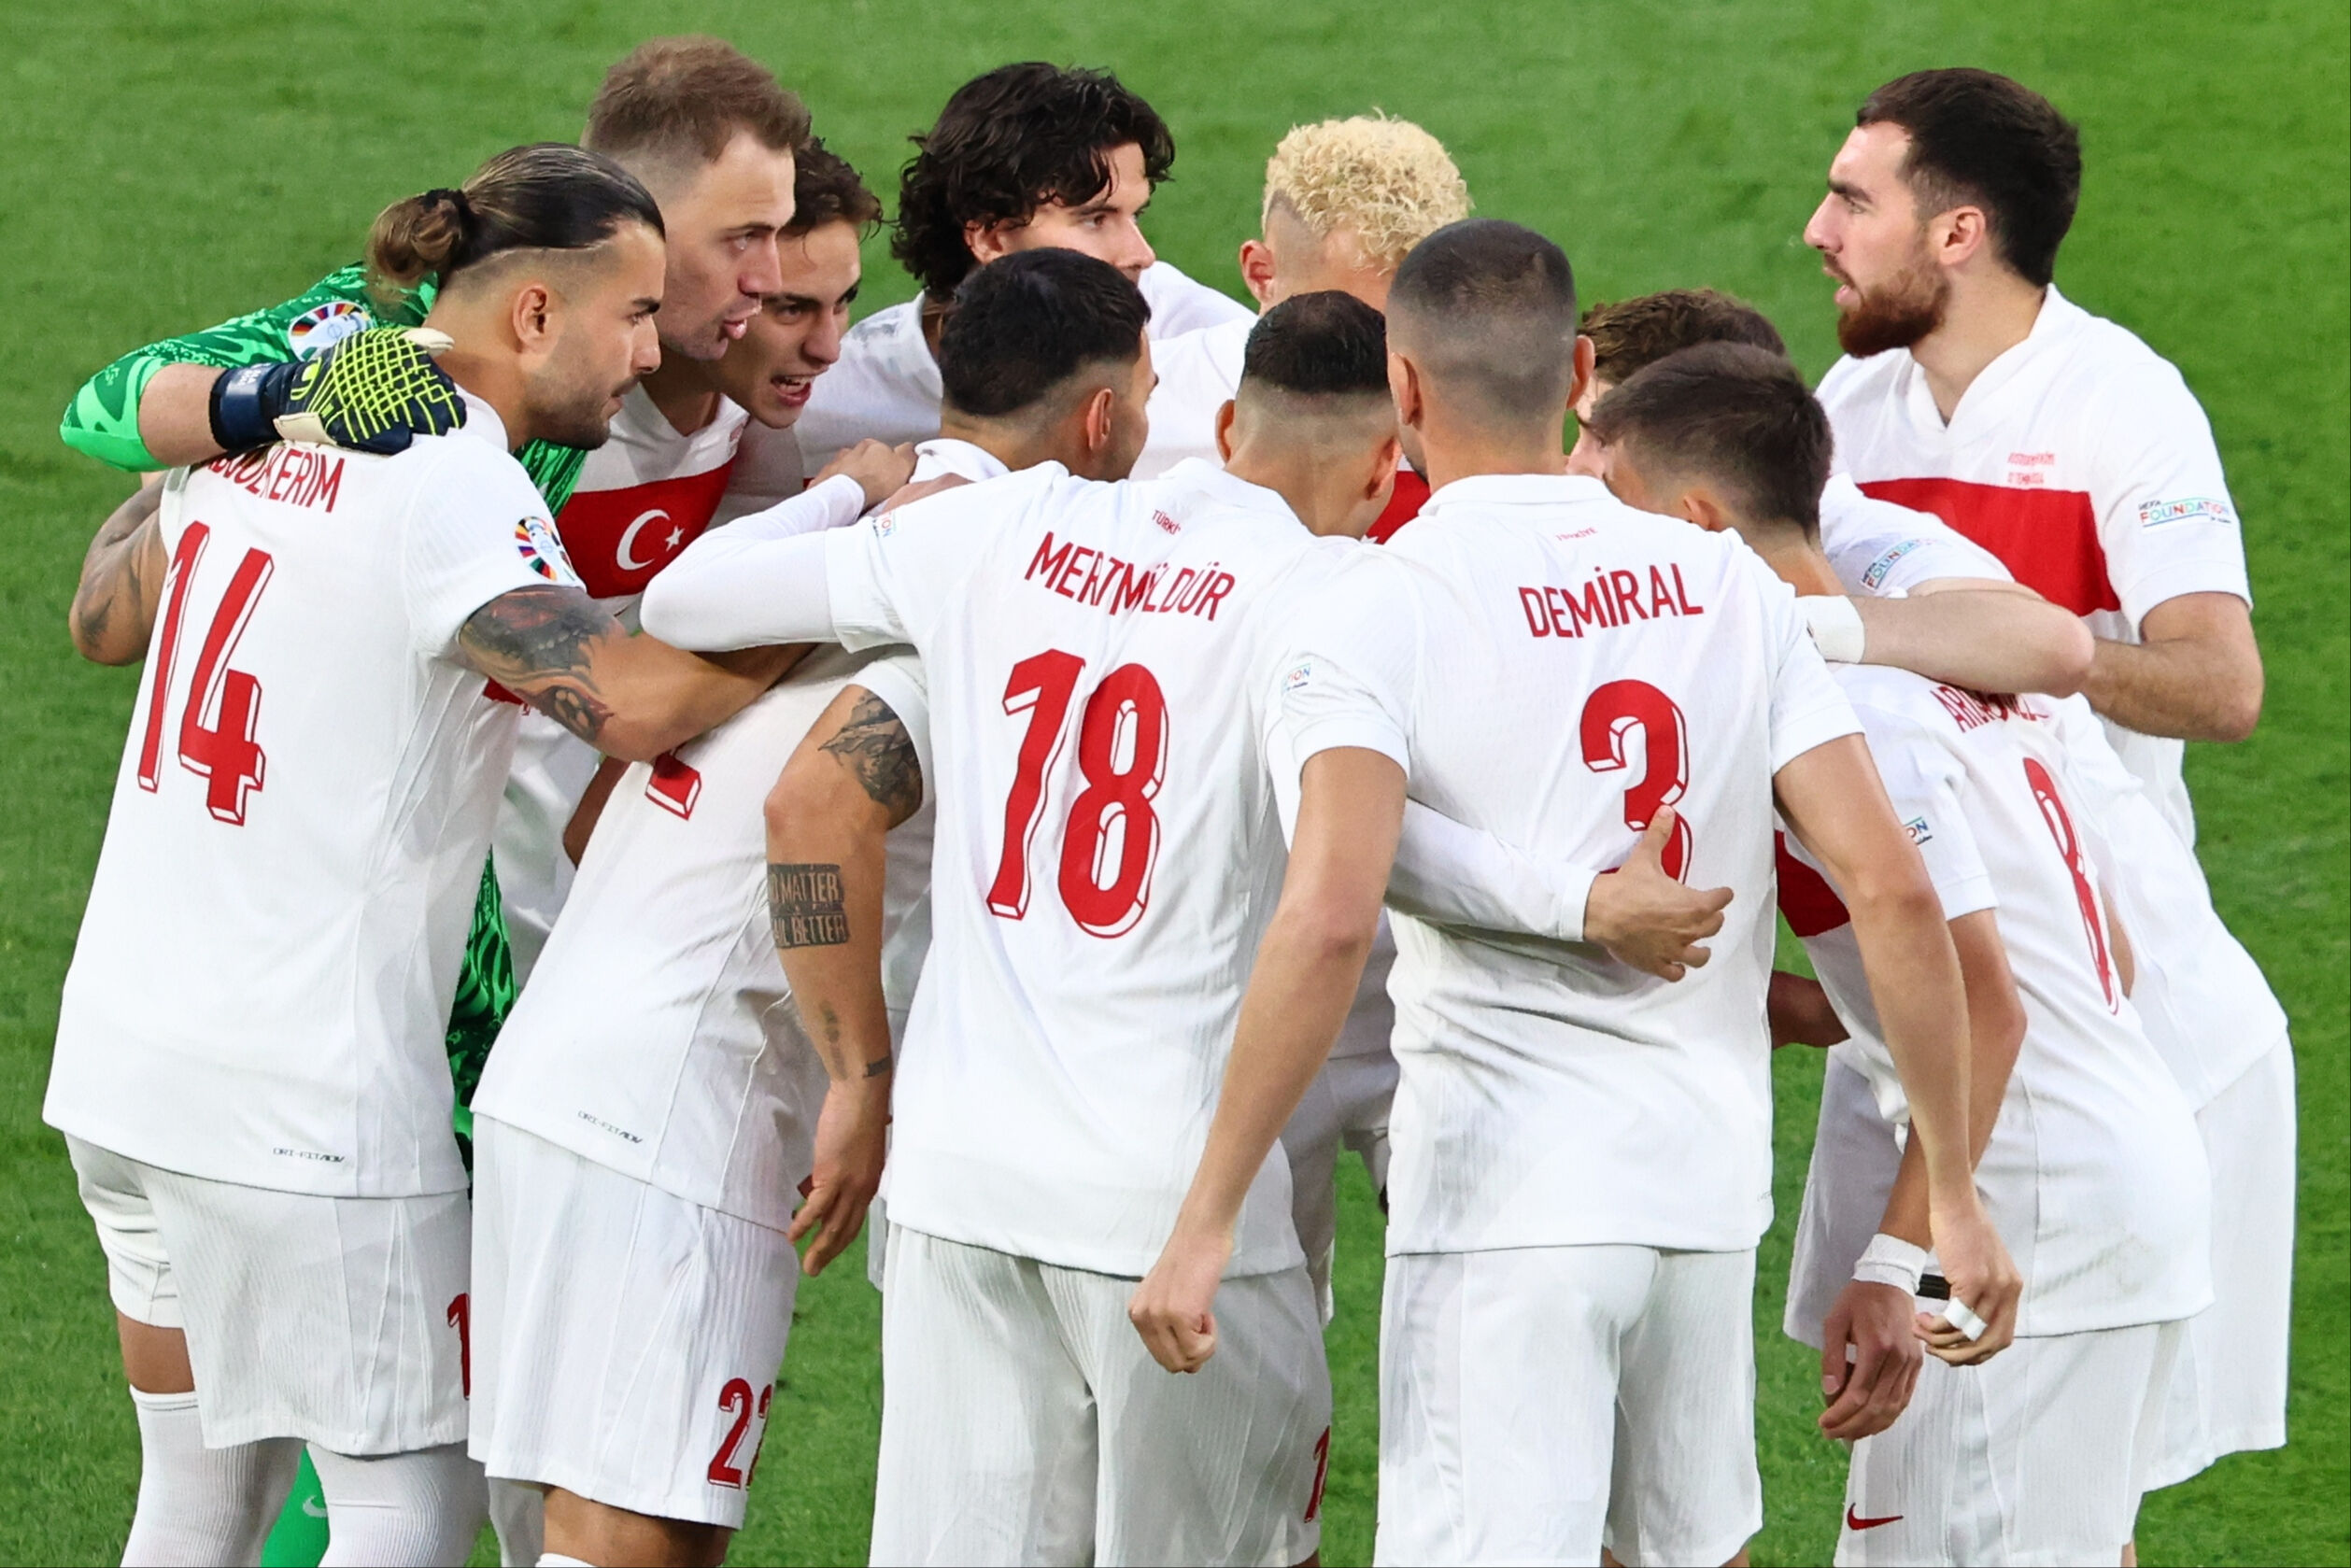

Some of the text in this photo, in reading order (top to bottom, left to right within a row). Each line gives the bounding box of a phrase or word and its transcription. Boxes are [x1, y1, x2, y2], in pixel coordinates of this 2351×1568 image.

[2139, 501, 2230, 524] FOUNDATON
[1518, 562, 1705, 639] DEMİRAL
[138, 520, 275, 827] 14
[986, 648, 1169, 939] 18
[1579, 679, 1692, 886] 3
[780, 871, 840, 905] MATTER
[791, 913, 846, 945] BETTER
